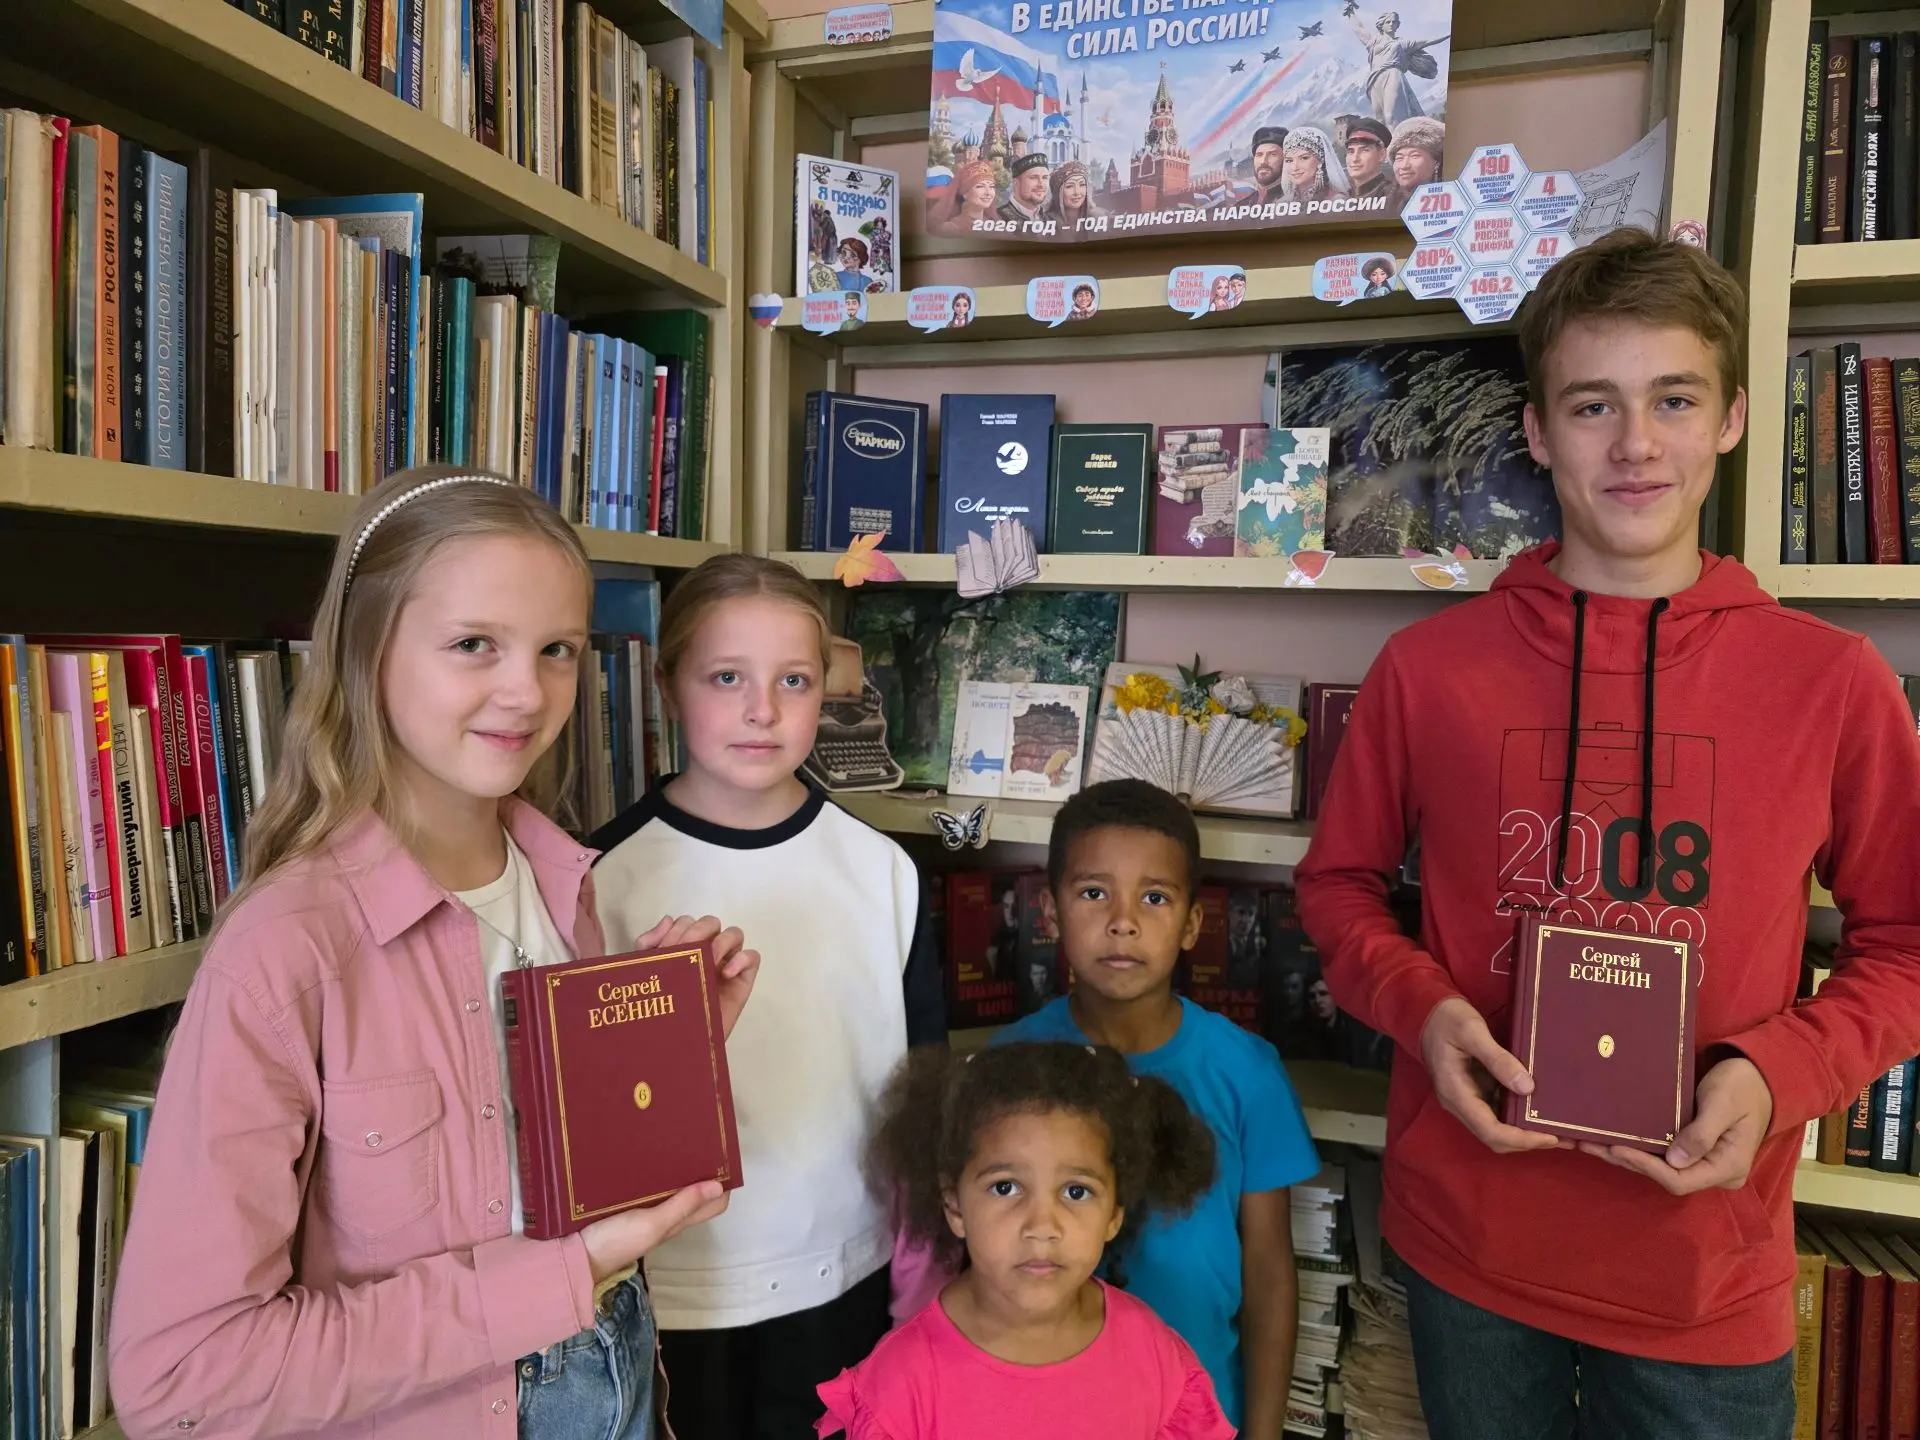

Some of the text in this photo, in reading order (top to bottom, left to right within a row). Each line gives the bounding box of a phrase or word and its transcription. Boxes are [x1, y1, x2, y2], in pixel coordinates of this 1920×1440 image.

[1011, 3, 1030, 32] В
[1066, 7, 1269, 59] СИЛА РОССИИ!
[411, 47, 421, 107] ДОРОГАМИ
[1477, 155, 1510, 176] 190
[1865, 131, 1878, 166] ВОЯЖ
[818, 186, 887, 210] Я ПОЗНАЮ
[1420, 193, 1451, 213] 270
[1542, 176, 1556, 196] 4
[214, 188, 228, 233] КРАЯ
[837, 203, 866, 219] МИР
[972, 218, 1017, 233] 2026
[1021, 219, 1056, 236] ГОД
[1075, 216, 1108, 232] ГОД
[1113, 208, 1209, 231] ЕДИНСТВА
[1212, 203, 1301, 222] НАРОДОВ
[1305, 196, 1387, 215] РОССИИ
[1864, 170, 1877, 239] ИМПЕРСКИЙ
[1474, 217, 1513, 229] НАРОДЫ
[1475, 229, 1510, 240] РОССИИ
[1325, 256, 1358, 267] РАЗНЫЕ
[1416, 248, 1454, 268] 80%
[1470, 241, 1513, 253] В ЦИФРАХ
[1536, 237, 1559, 256] 47
[214, 236, 228, 344] РЯЗАНСКОГО
[156, 173, 174, 459] ИСТОРИЯ ОДНОЙ ГУБЕРНИИ
[177, 301, 185, 357] РЯЗАНСКОГО
[103, 314, 116, 356] ИЙЕШ
[104, 365, 116, 406] ДЮЛА
[177, 359, 185, 400] ИСТОРИИ
[177, 402, 185, 436] ОЧЕРКИ
[855, 435, 900, 450] МАРКИН
[1844, 383, 1861, 502] В СЕТЯХ ИНТРИГИ
[196, 693, 213, 754] ОТПОР
[230, 676, 243, 739] Избранное
[156, 667, 180, 806] АНАТОЛИЙ РУСАКОВ
[171, 691, 191, 767] НАТАША
[111, 722, 130, 776] ПОДВИГ
[206, 794, 221, 860] ОЛЕНИЧЕВ
[1498, 809, 1711, 908] 2008
[32, 869, 46, 951] ЯКОВ ПОЛОНСКИЙ
[1581, 946, 1641, 969] Сергей
[598, 974, 662, 1003] Сергей
[1569, 963, 1651, 989] ЕСЕНИН
[588, 995, 675, 1028] ЕСЕНИН
[1603, 1041, 1610, 1051] 7
[638, 1089, 647, 1101] 6
[1885, 1090, 1902, 1115] ВЕРНЕРА
[1881, 1117, 1899, 1161] ПРИКЛЮЧЕНИЯ
